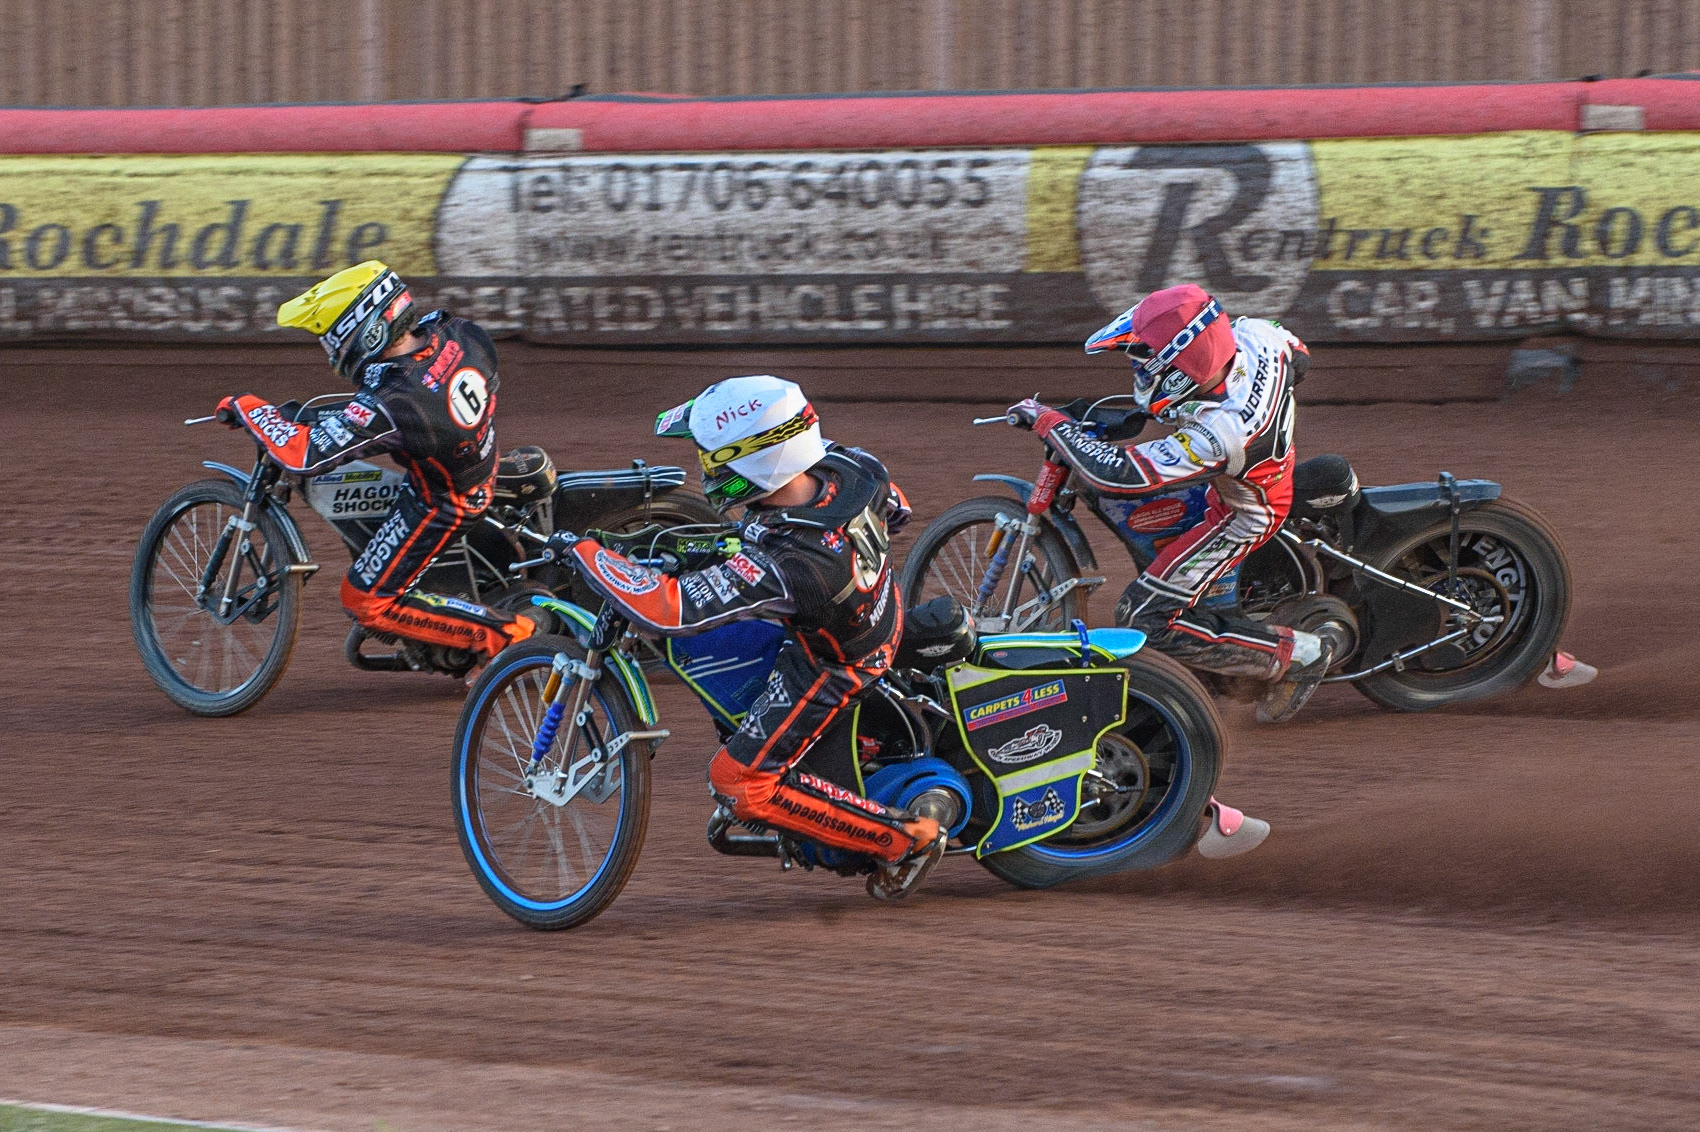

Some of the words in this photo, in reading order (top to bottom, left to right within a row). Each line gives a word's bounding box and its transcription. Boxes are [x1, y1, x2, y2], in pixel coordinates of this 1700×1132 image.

[459, 380, 482, 416] 6
[715, 398, 763, 431] Nick
[333, 500, 395, 514] SHOCK
[354, 508, 402, 574] SHOCKS
[363, 515, 411, 586] HAGON
[969, 695, 1020, 720] CARPETS
[1021, 687, 1033, 706] 4
[1033, 682, 1060, 701] LESS
